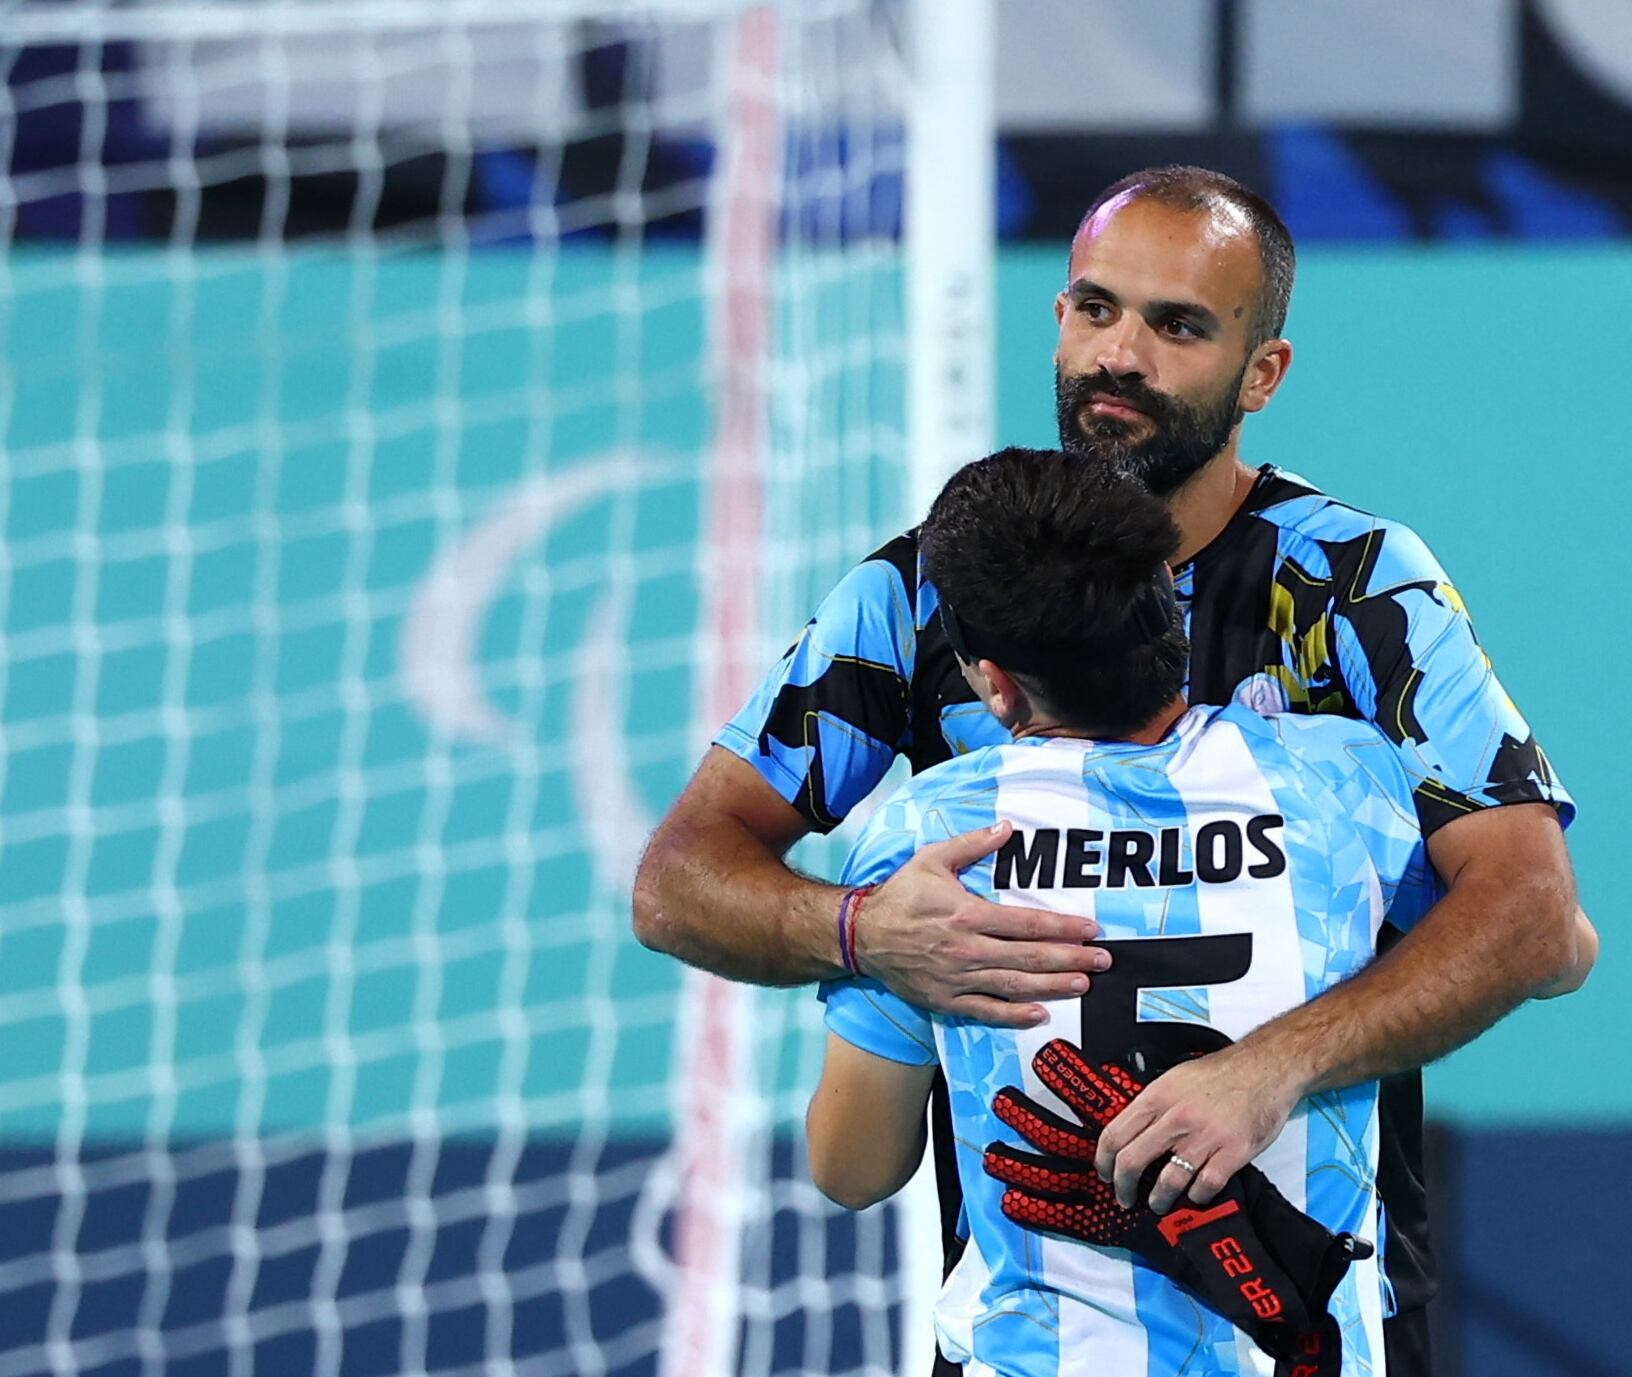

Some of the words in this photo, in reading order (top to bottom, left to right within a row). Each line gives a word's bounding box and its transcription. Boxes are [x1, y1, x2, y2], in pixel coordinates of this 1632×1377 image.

[993, 813, 1287, 891] MERLOS
[1081, 932, 1253, 1090] 5
[1041, 1047, 1059, 1065] 23
[1056, 1061, 1105, 1108] LEADER
[1209, 1236, 1254, 1278] 23
[1240, 1277, 1286, 1323] ER
[1302, 1331, 1322, 1355] 2
